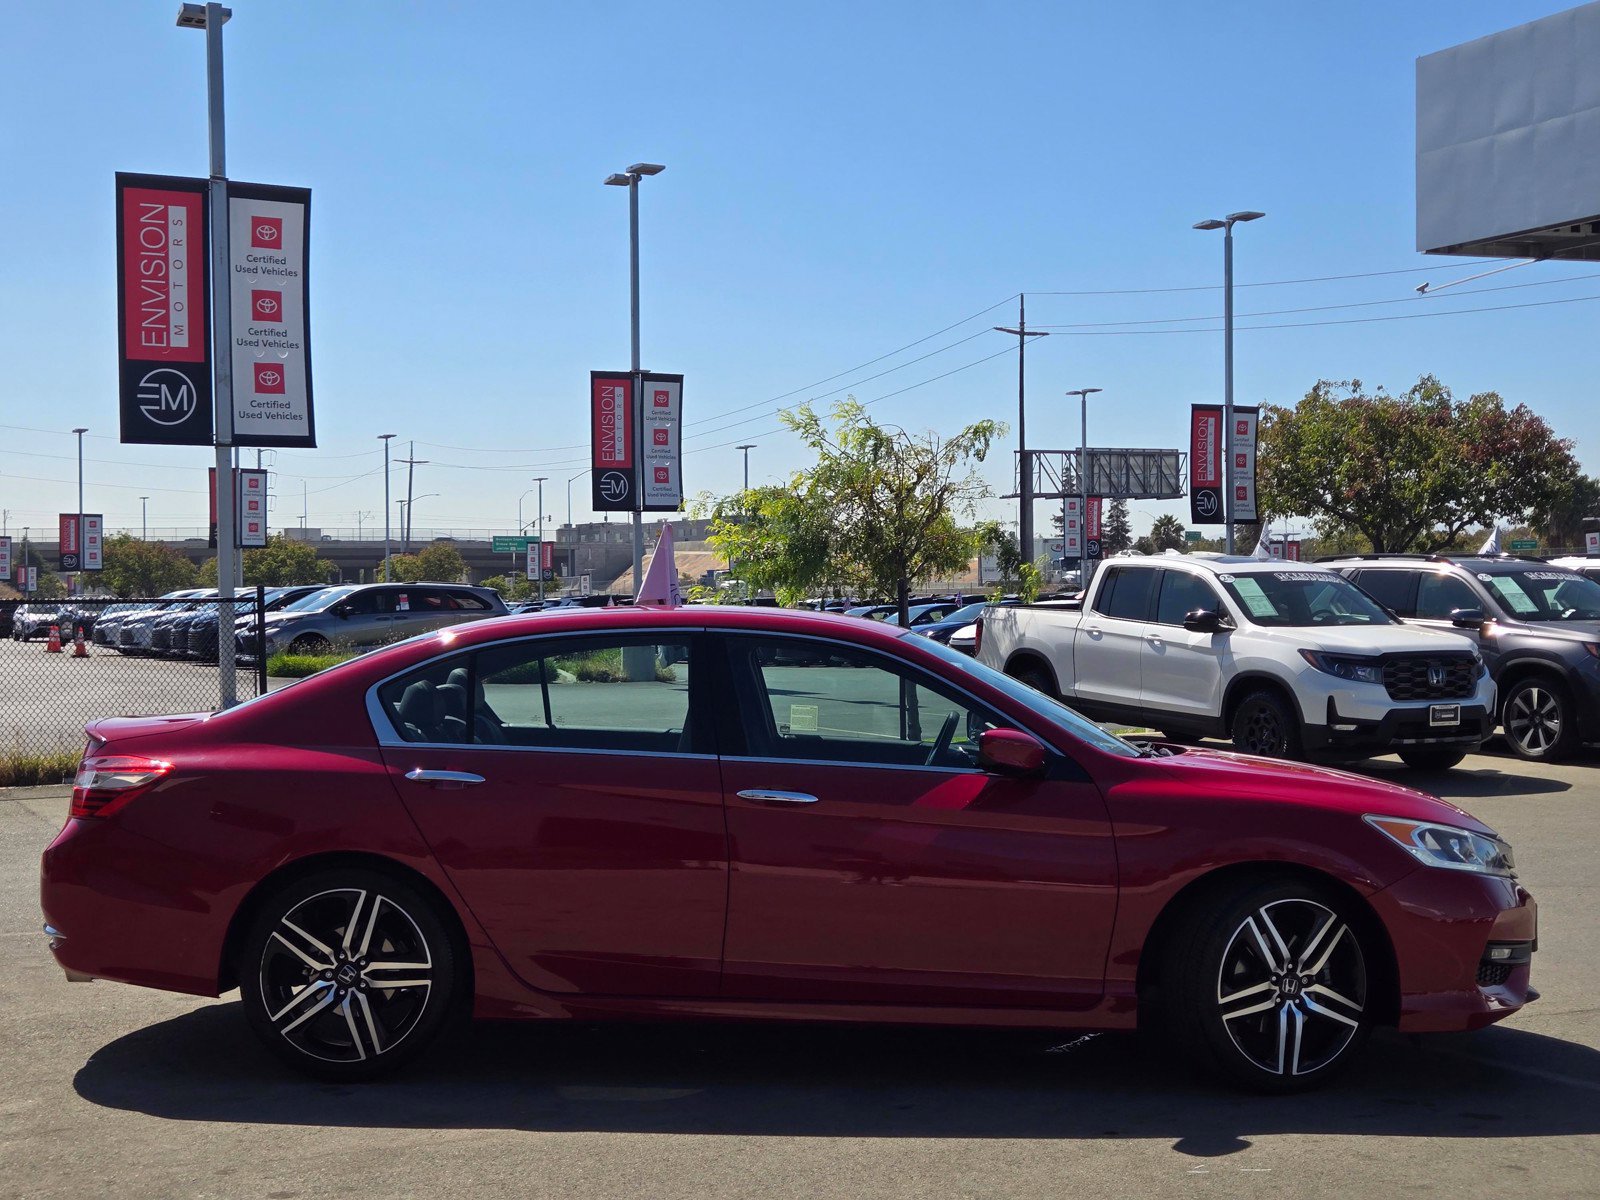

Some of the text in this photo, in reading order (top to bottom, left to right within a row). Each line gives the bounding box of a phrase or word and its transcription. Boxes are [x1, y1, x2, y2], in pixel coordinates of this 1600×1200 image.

[246, 254, 287, 265] Certified
[139, 203, 167, 348] ENVISION
[172, 218, 184, 336] MOTORS
[235, 265, 298, 278] Used Vehicles
[247, 327, 288, 338] Certified
[236, 338, 300, 349] Used Vehicles
[250, 399, 291, 409] Certified
[238, 410, 303, 421] Used Vehicles
[601, 386, 614, 461] ENVISION
[1198, 416, 1208, 481] ENVISION
